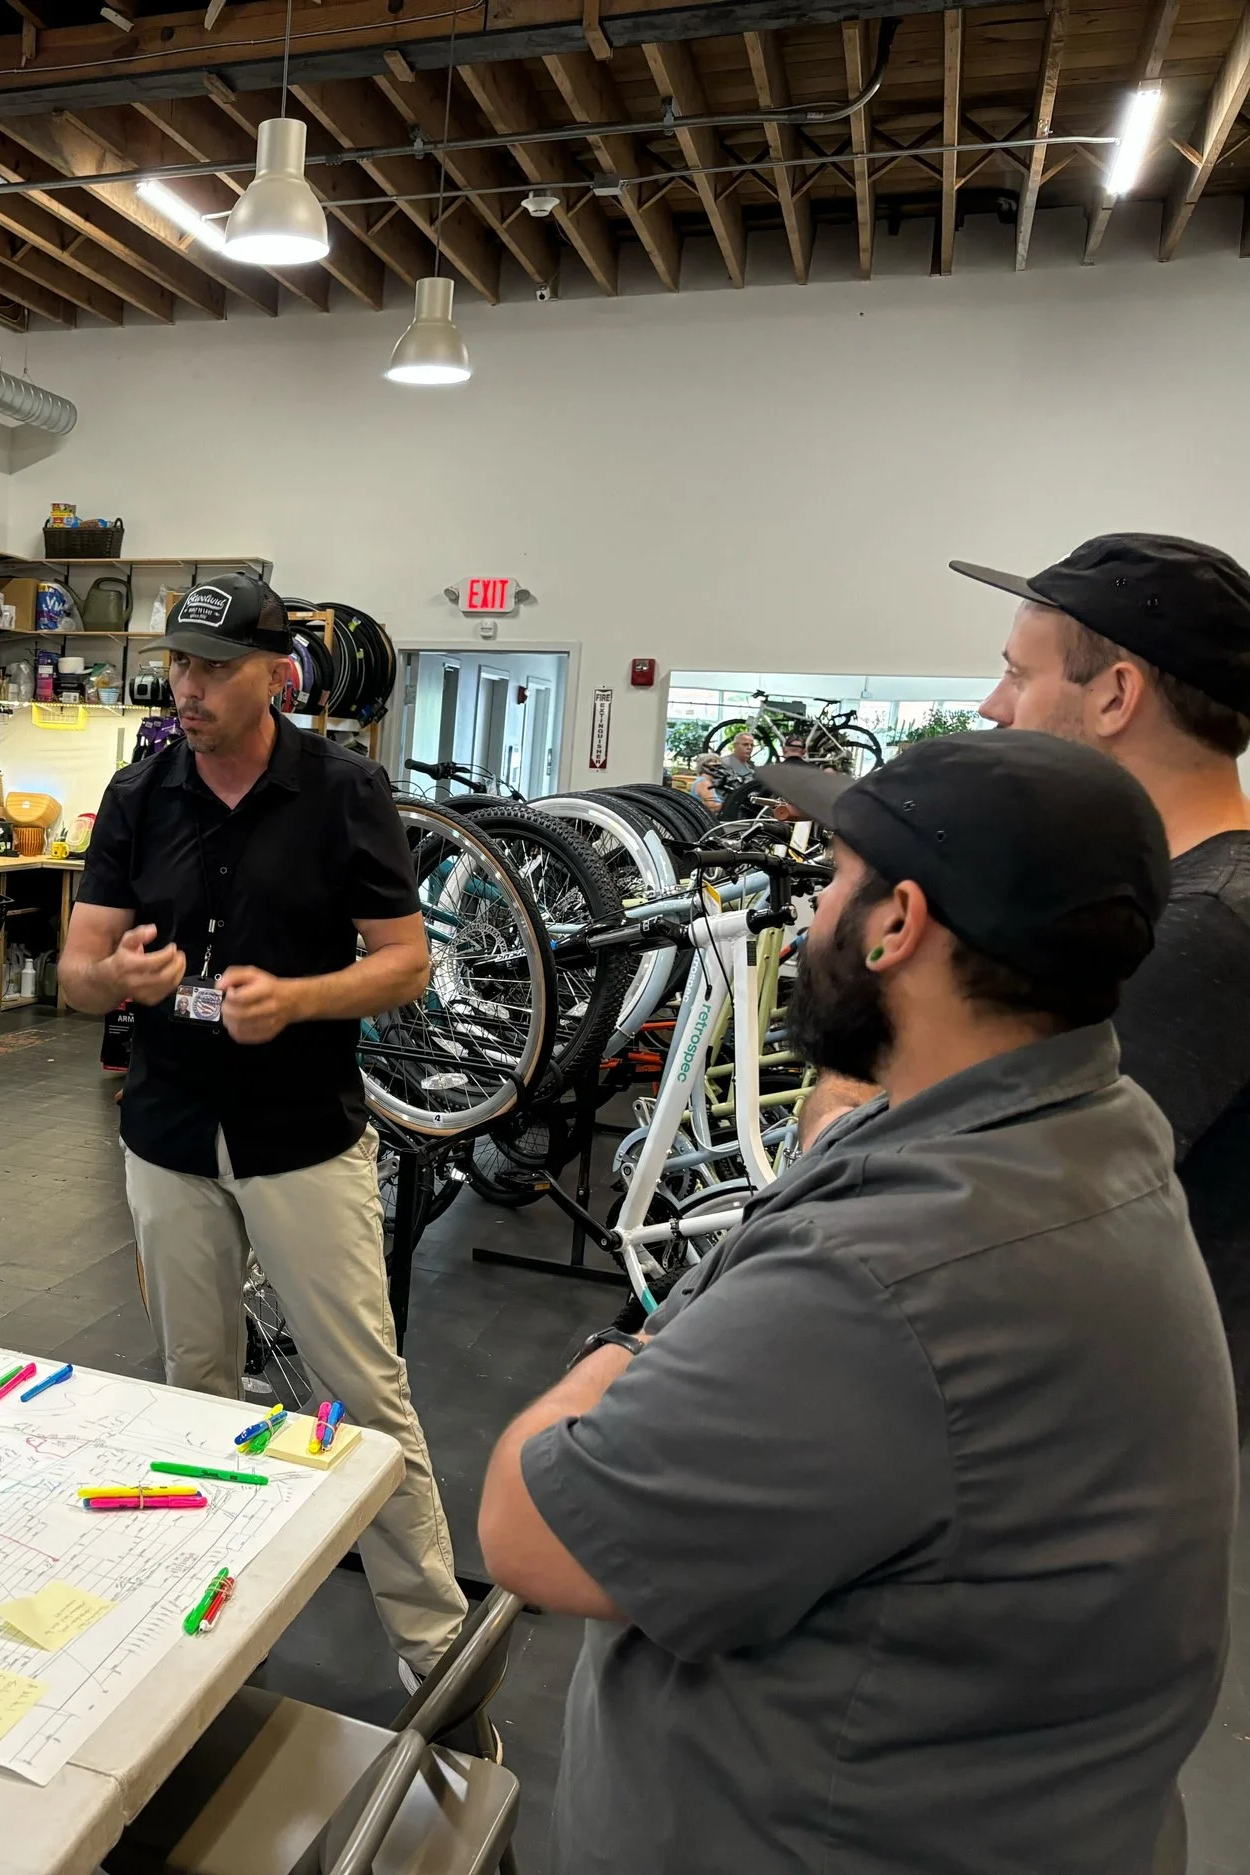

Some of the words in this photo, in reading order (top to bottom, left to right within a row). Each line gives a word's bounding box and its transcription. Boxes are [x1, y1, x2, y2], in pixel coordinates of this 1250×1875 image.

[468, 579, 509, 609] EXIT
[595, 693, 611, 702] FIRE
[595, 702, 605, 764] EXTINGUISHER
[677, 1003, 712, 1083] retrospec
